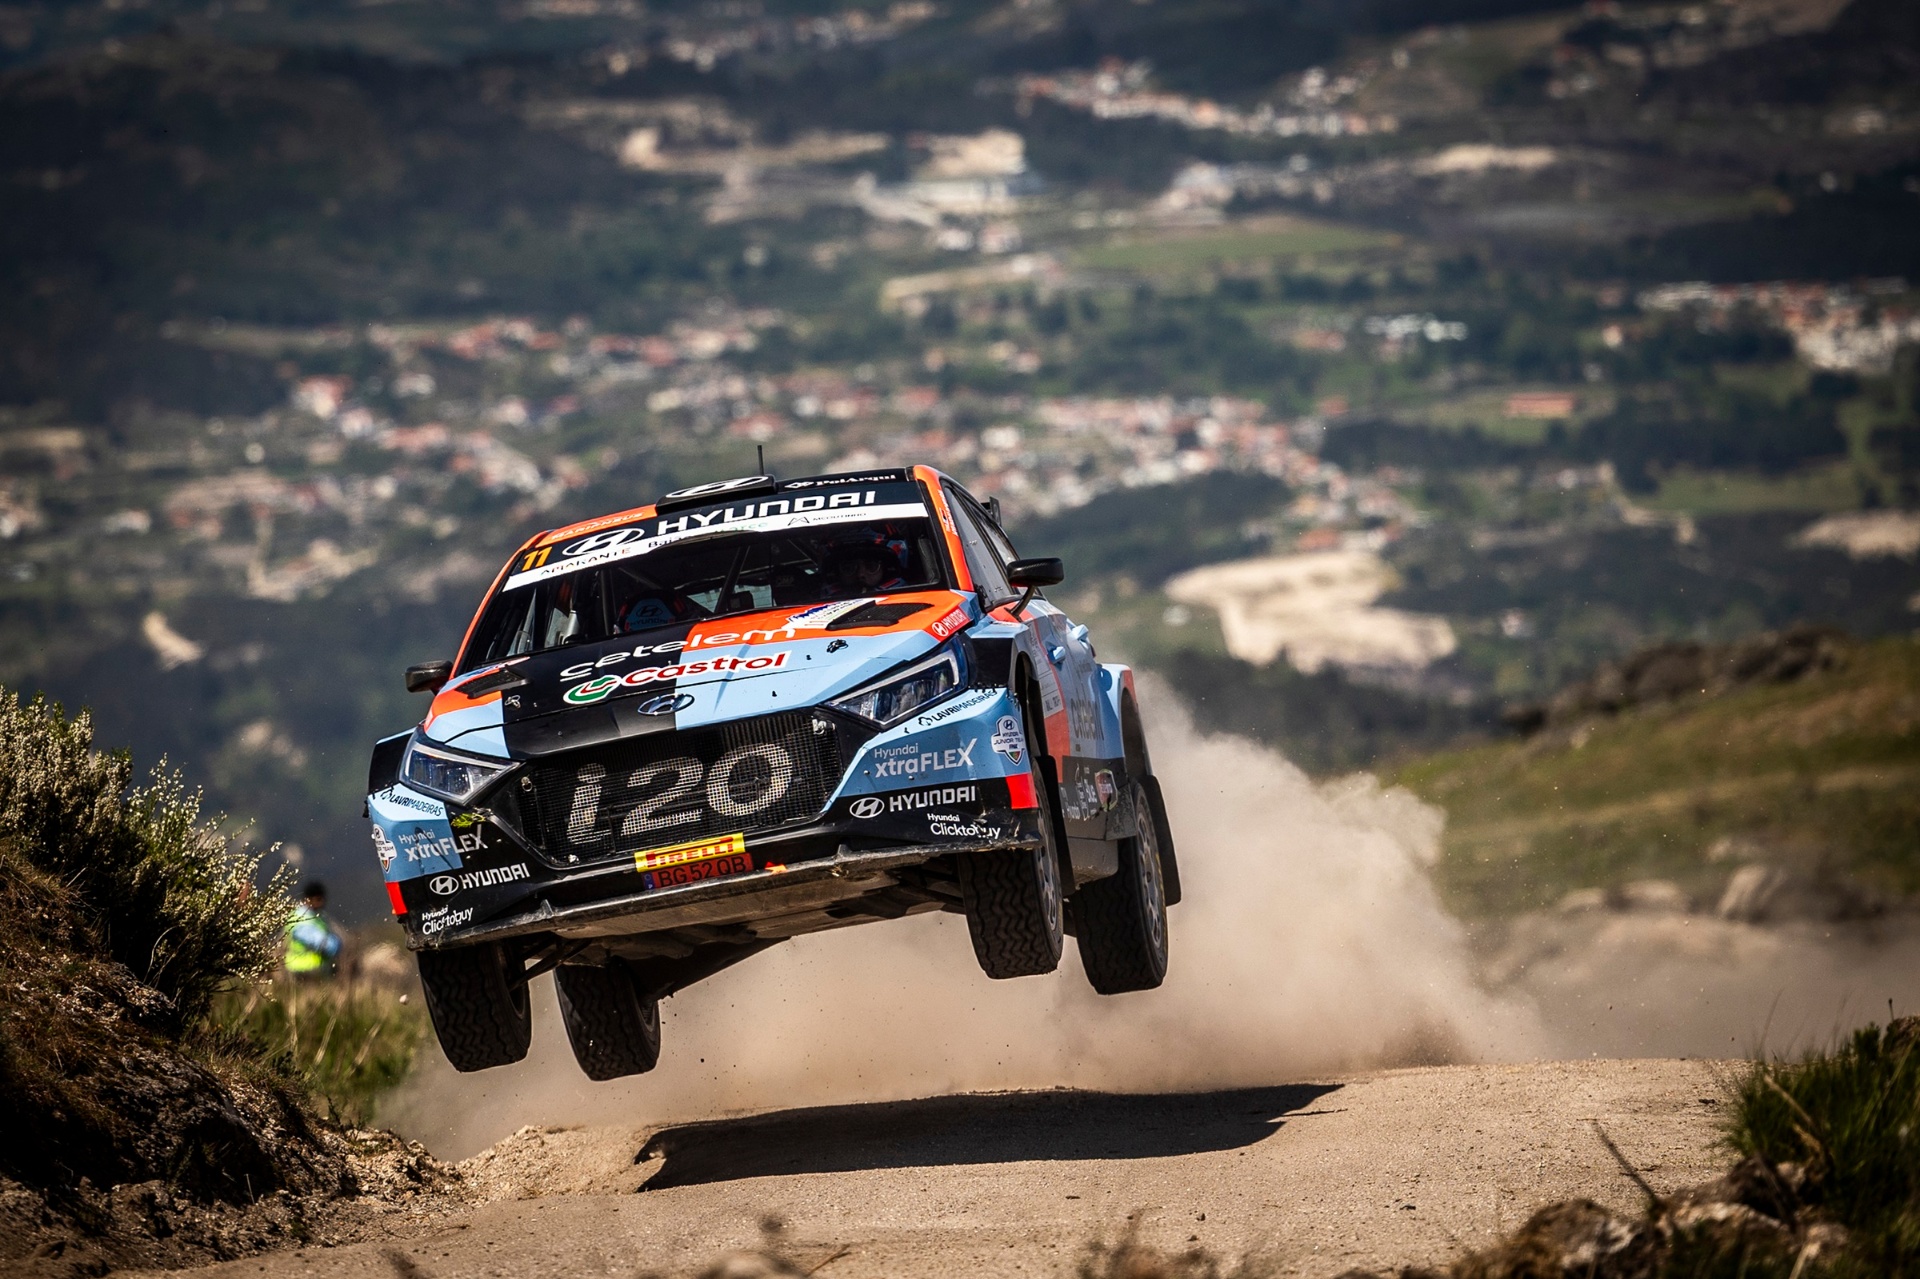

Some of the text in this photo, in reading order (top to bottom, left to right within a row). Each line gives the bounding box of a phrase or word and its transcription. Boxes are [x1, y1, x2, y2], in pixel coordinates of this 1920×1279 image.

[658, 490, 876, 536] HYUNDAI
[521, 546, 552, 572] 11
[560, 628, 796, 678] cetelem
[624, 651, 787, 686] Castrol
[874, 743, 919, 759] Hyundai
[875, 738, 978, 778] xtraFLEX
[389, 794, 444, 817] LAVRIMADEIRAS
[566, 743, 793, 845] i20
[889, 786, 976, 812] HYUNDAI
[926, 813, 960, 822] Hyundai
[398, 829, 436, 845] Hyundai
[404, 823, 488, 862] xtraFLEX
[645, 836, 734, 868] PIRELLI
[460, 863, 531, 889] HYUNDAI
[657, 867, 688, 887] BG
[689, 861, 713, 881] 52
[421, 904, 449, 921] Hyundai
